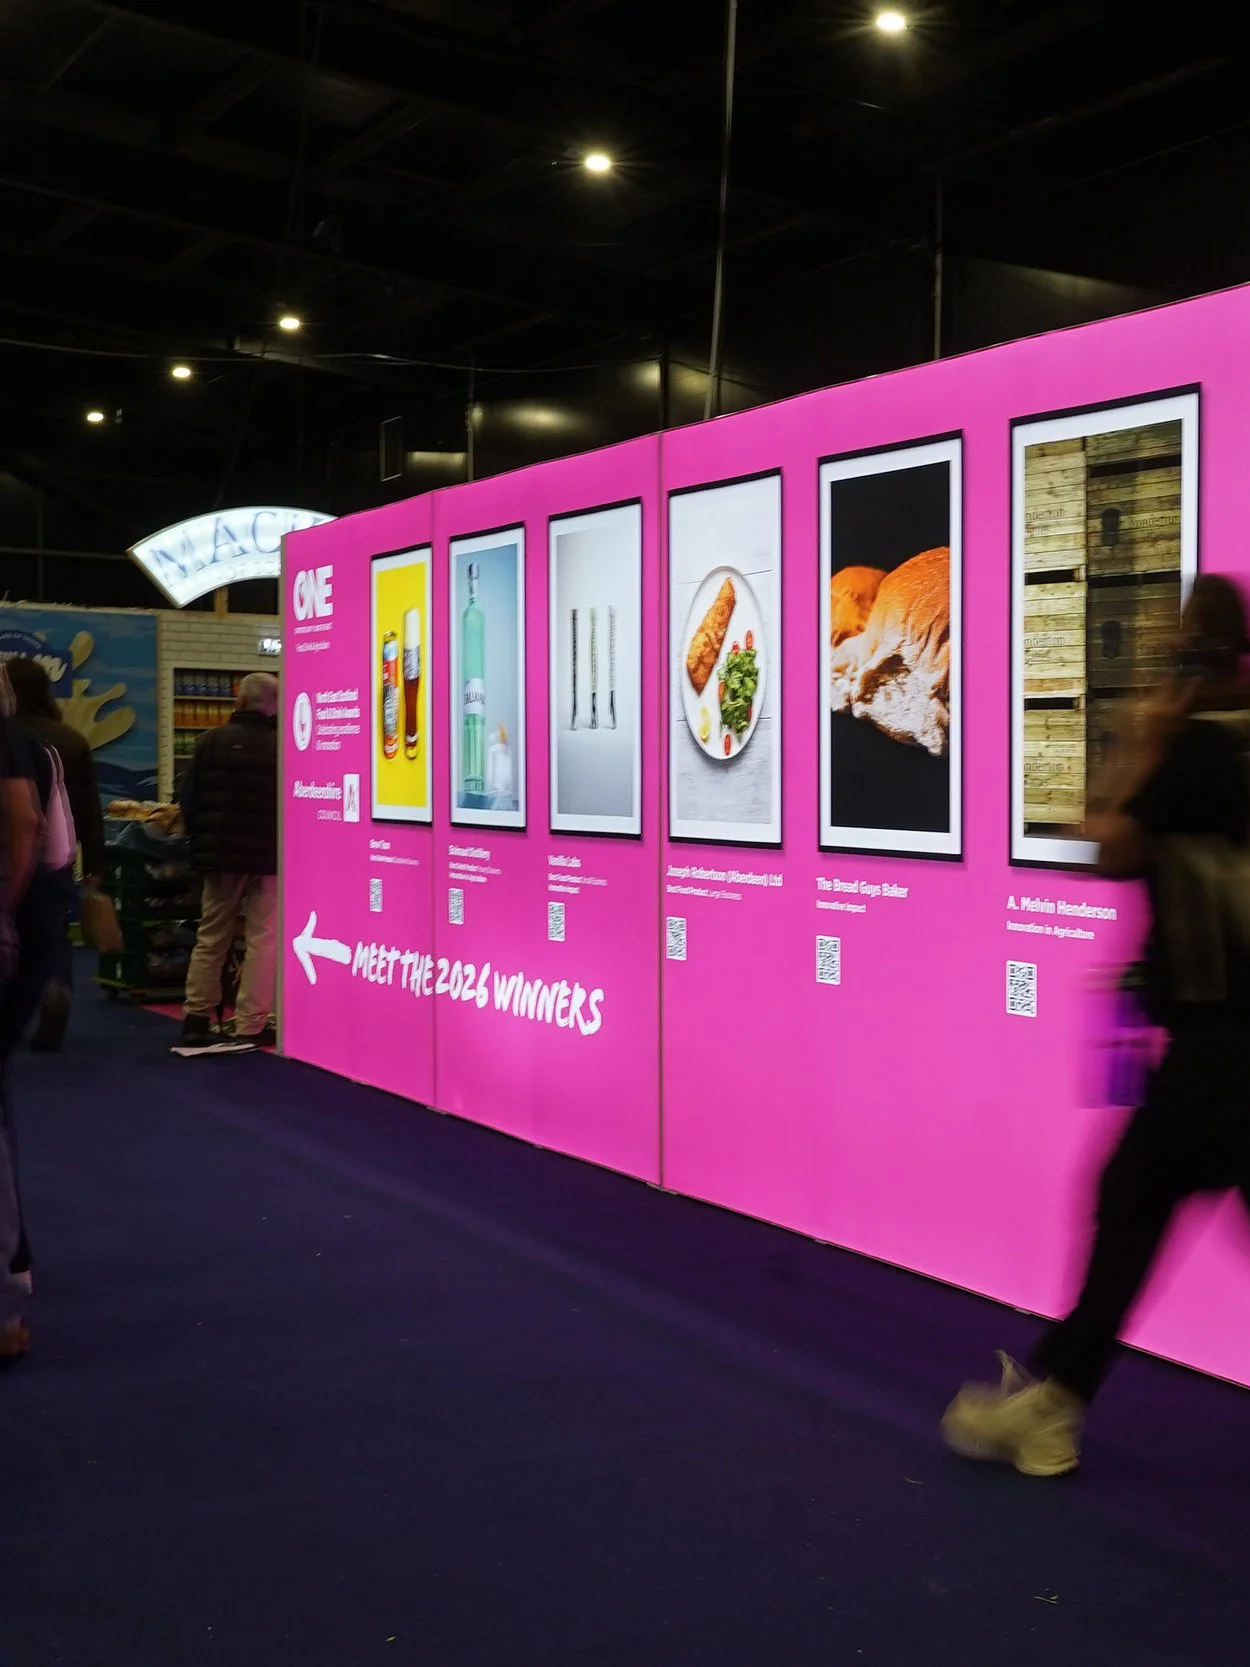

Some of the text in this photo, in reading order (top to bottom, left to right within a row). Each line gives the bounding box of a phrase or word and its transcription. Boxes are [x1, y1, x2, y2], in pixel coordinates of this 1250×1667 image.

[293, 564, 334, 622] ONE
[816, 877, 833, 891] The
[833, 878, 859, 894] Bread
[859, 880, 882, 898] Guys
[1007, 896, 1117, 921] A. Melvin Henderson
[352, 940, 604, 1036] MEET THE 2026 WINNERS
